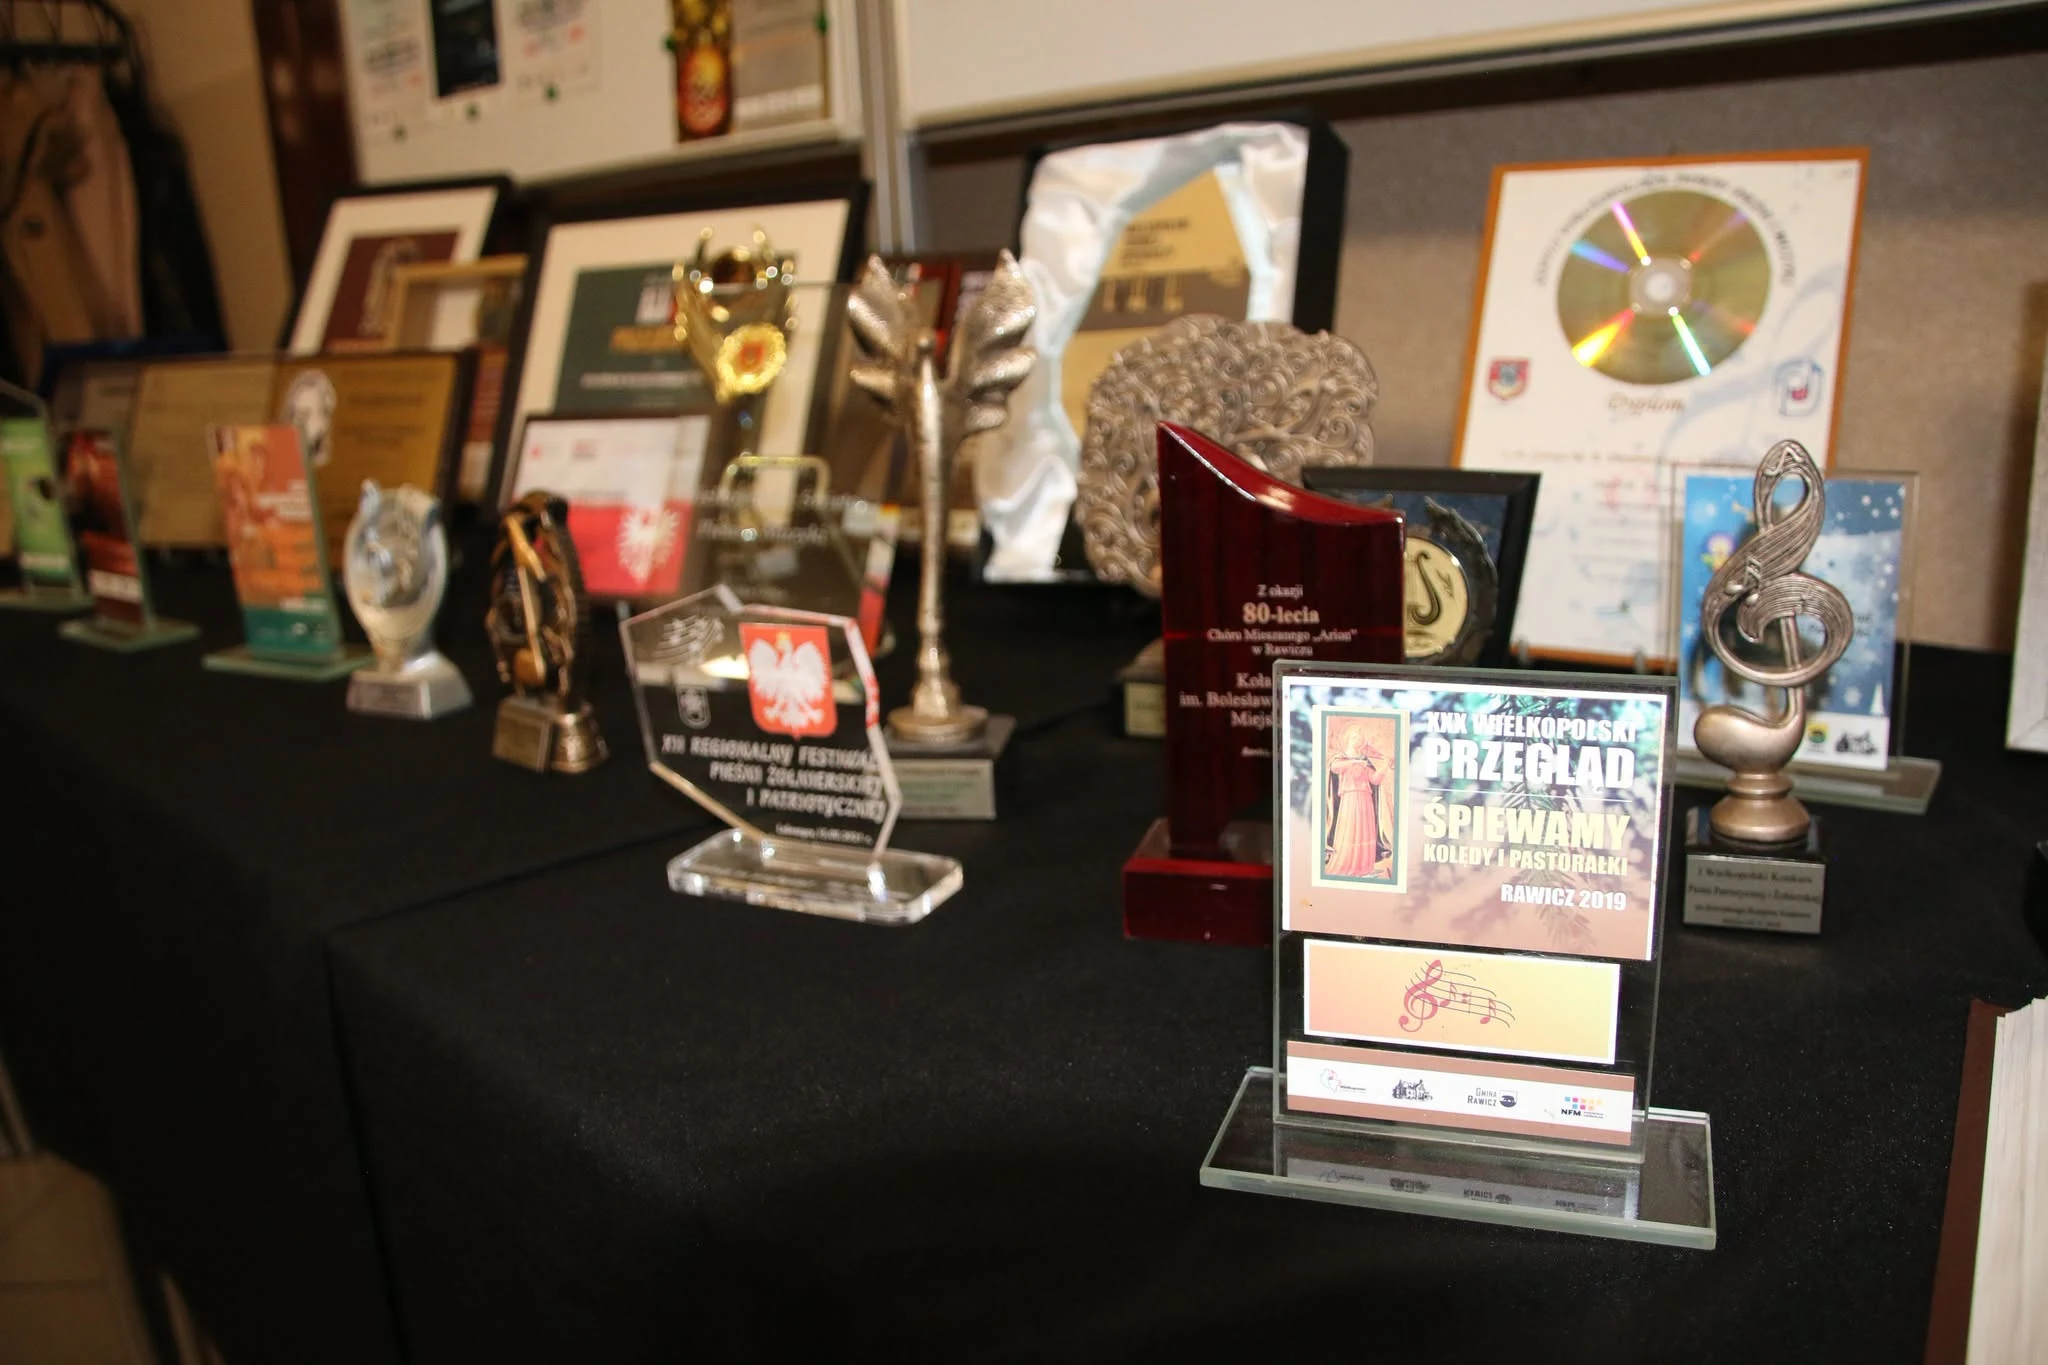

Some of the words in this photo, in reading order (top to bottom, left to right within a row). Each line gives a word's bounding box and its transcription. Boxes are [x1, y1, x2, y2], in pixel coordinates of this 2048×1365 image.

[1242, 602, 1320, 624] 80-lecia
[1206, 691, 1273, 708] Bolesław
[1230, 710, 1273, 730] Miejs
[1426, 711, 1468, 734] XXX
[1472, 713, 1637, 743] WIELKOPOLSKI
[1424, 737, 1635, 793] PRZEGLĄD
[1423, 797, 1631, 850] ŚPIEWAMY
[1423, 843, 1494, 867] KOLĘDY
[1498, 849, 1504, 866] I
[1509, 850, 1628, 876] PASTORAŁKI
[1501, 884, 1575, 906] RAWICZ
[1578, 889, 1627, 911] 2019
[1561, 1108, 1581, 1116] NFM
